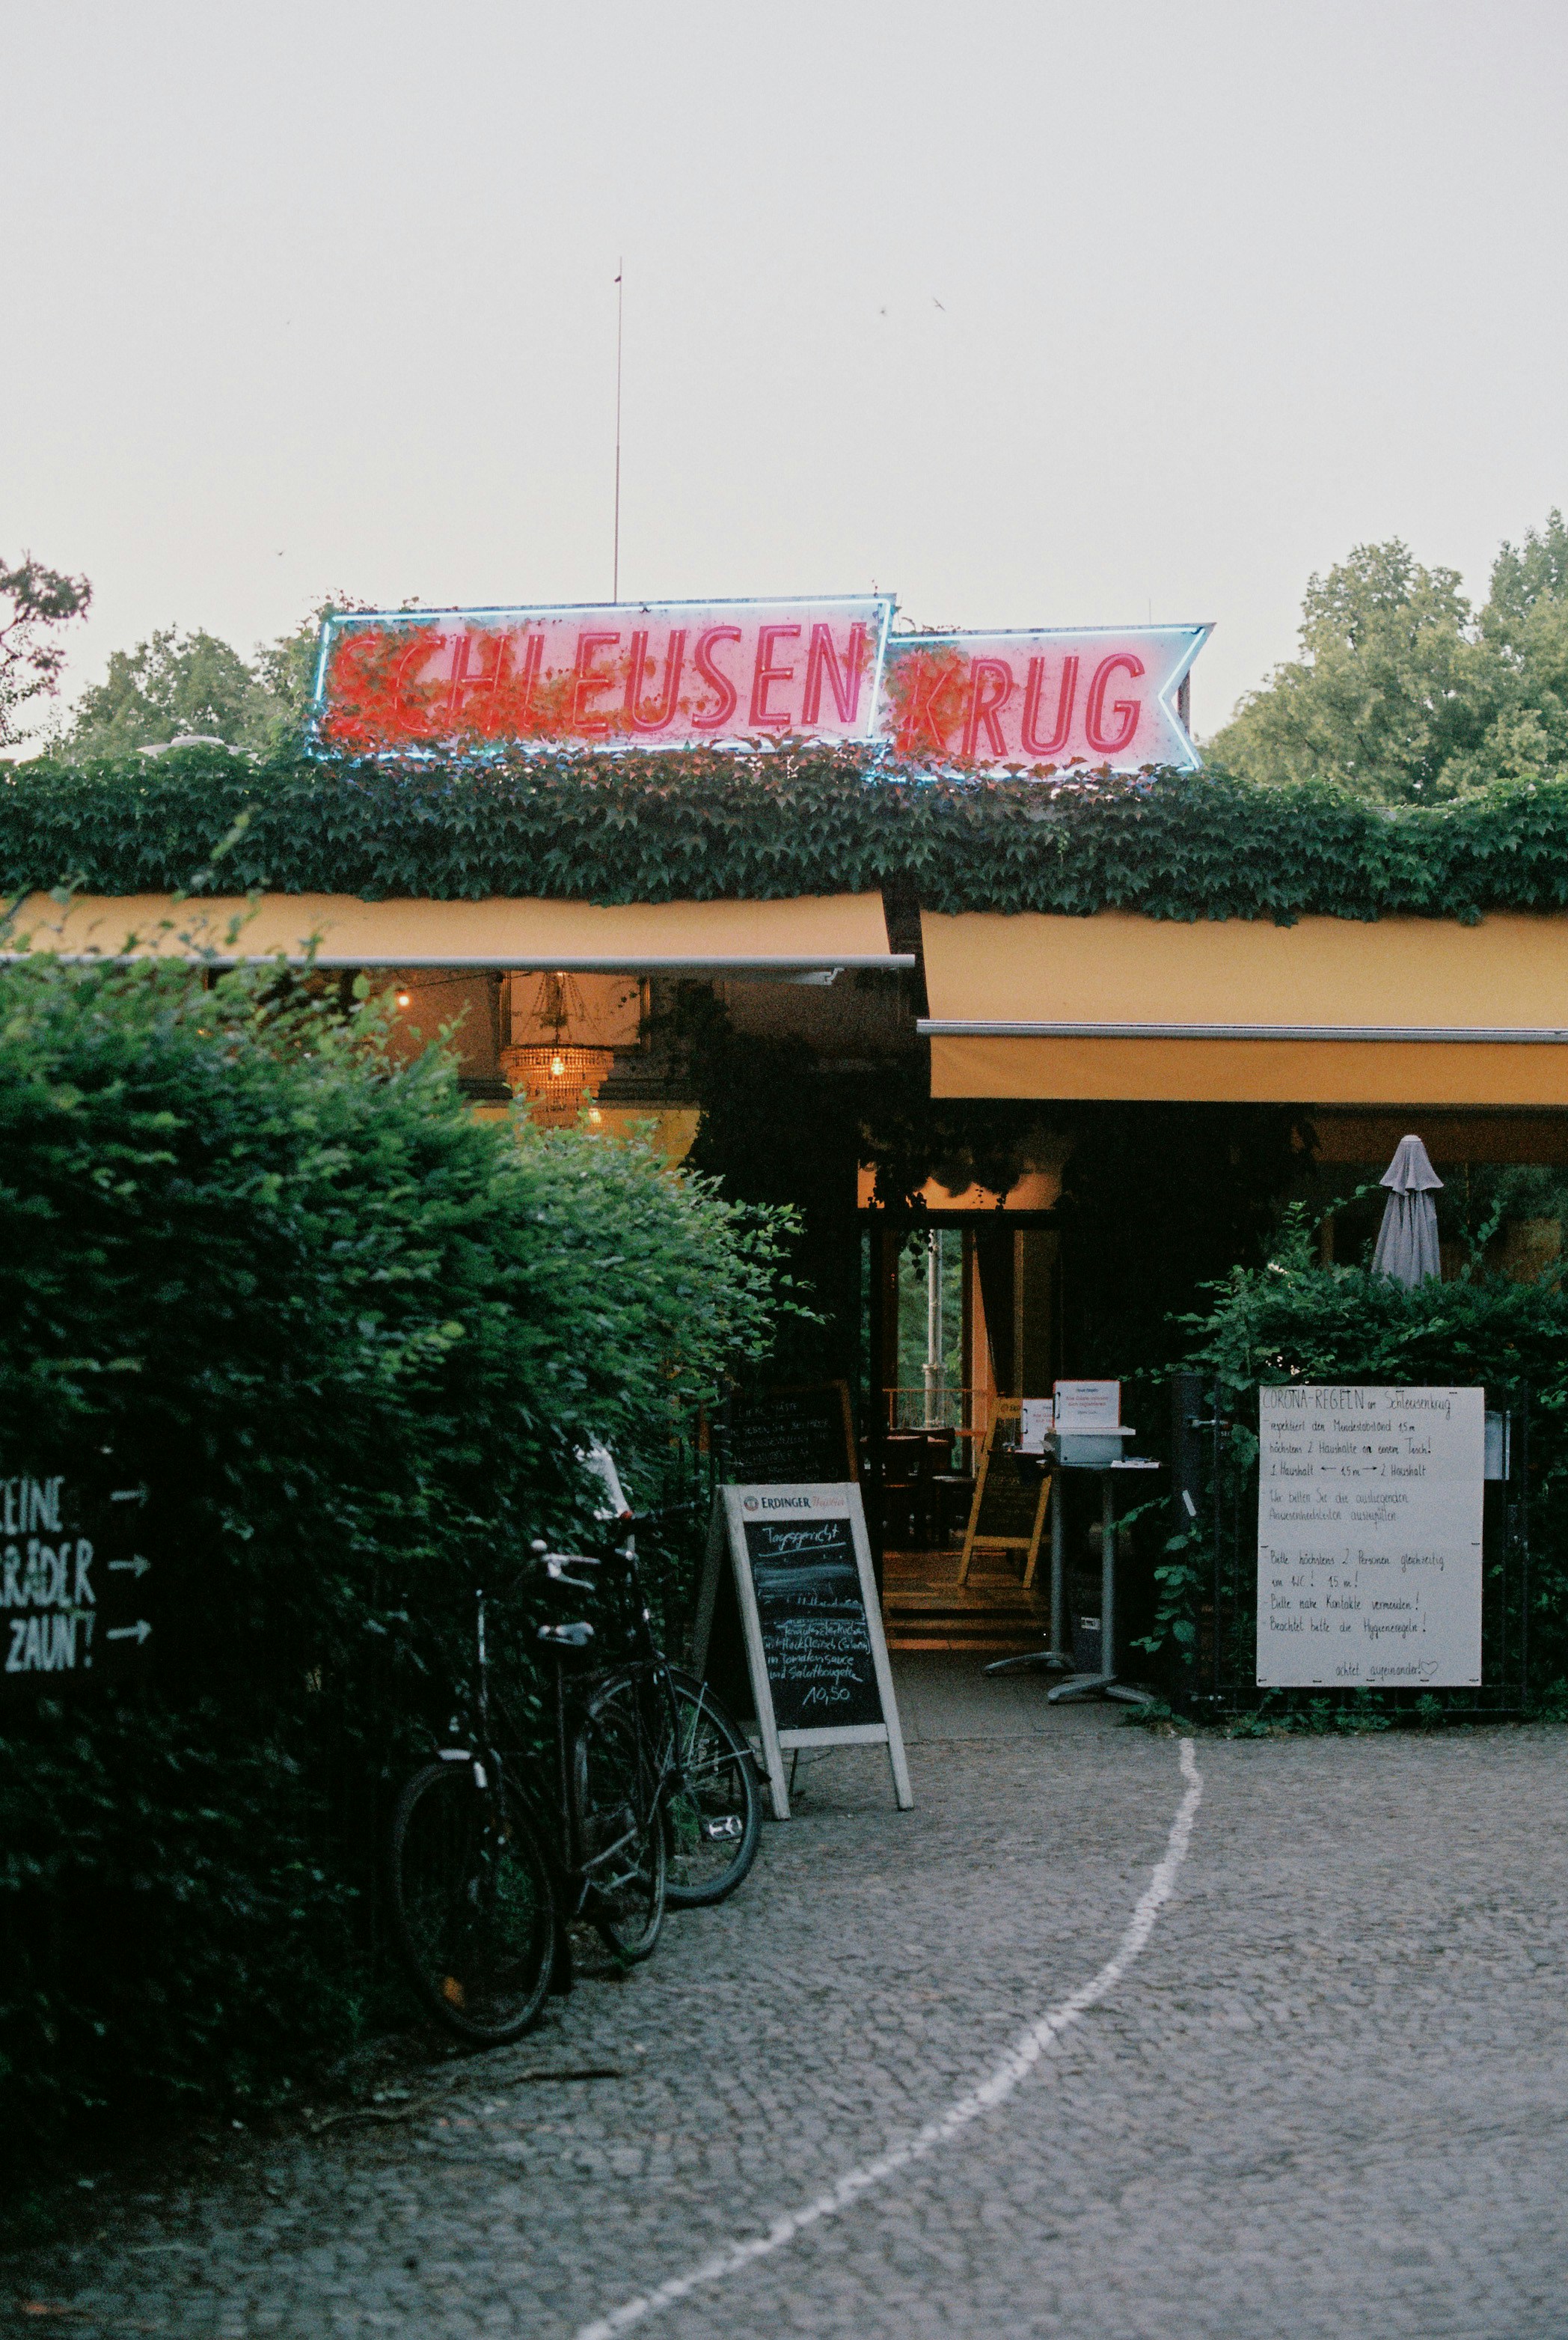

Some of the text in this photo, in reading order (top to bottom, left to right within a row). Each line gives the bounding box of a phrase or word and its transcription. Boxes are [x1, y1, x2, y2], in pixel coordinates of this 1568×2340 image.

[900, 653, 1145, 757] KRUG
[1263, 1388, 1365, 1410] CORONA-REGELN
[1312, 1421, 1325, 1432] den
[1319, 1441, 1356, 1454] Haushalte
[1280, 1461, 1314, 1476] Haushalt
[1391, 1464, 1426, 1476] Haushalt
[0, 1473, 64, 1534] EINE
[761, 1497, 812, 1509] ERDINGER
[1270, 1549, 1289, 1565] Bitte
[1299, 1549, 1335, 1565] höchstens
[1358, 1549, 1390, 1565] Personen
[1400, 1551, 1445, 1573] gleichzeitig
[0, 1538, 97, 1608] RÄDER
[1270, 1593, 1291, 1610] Bitte
[1299, 1597, 1317, 1610] nahe
[1326, 1594, 1362, 1610] Kontakte
[1270, 1615, 1304, 1632] Beachtet
[1310, 1617, 1330, 1632] bitte
[1335, 1661, 1359, 1676] achtet
[802, 1686, 850, 1705] 10,50
